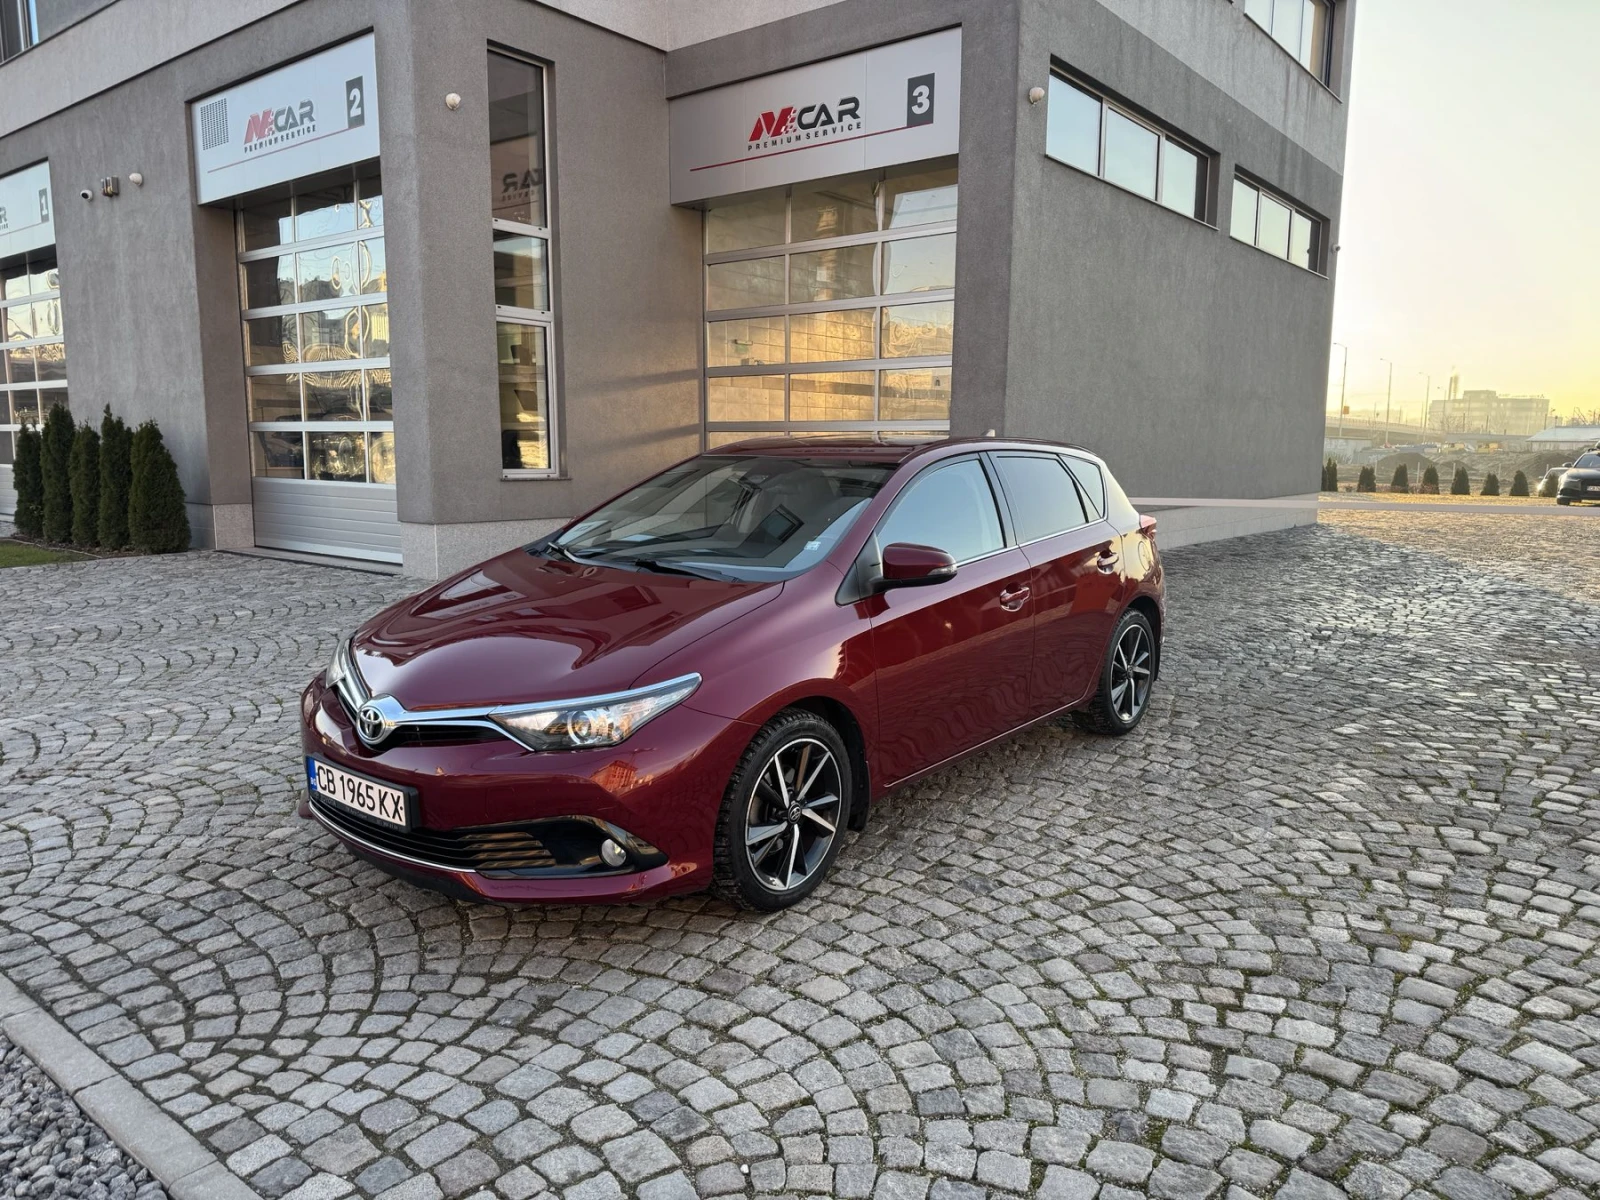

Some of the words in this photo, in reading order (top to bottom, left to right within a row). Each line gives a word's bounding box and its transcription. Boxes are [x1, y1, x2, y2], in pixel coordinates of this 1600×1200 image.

[349, 88, 361, 118] 2
[911, 85, 930, 115] 3
[747, 134, 802, 151] PREMIUM
[805, 121, 862, 140] SERVICE
[41, 195, 48, 215] 1
[317, 765, 337, 795] CB
[339, 774, 376, 812] 1965
